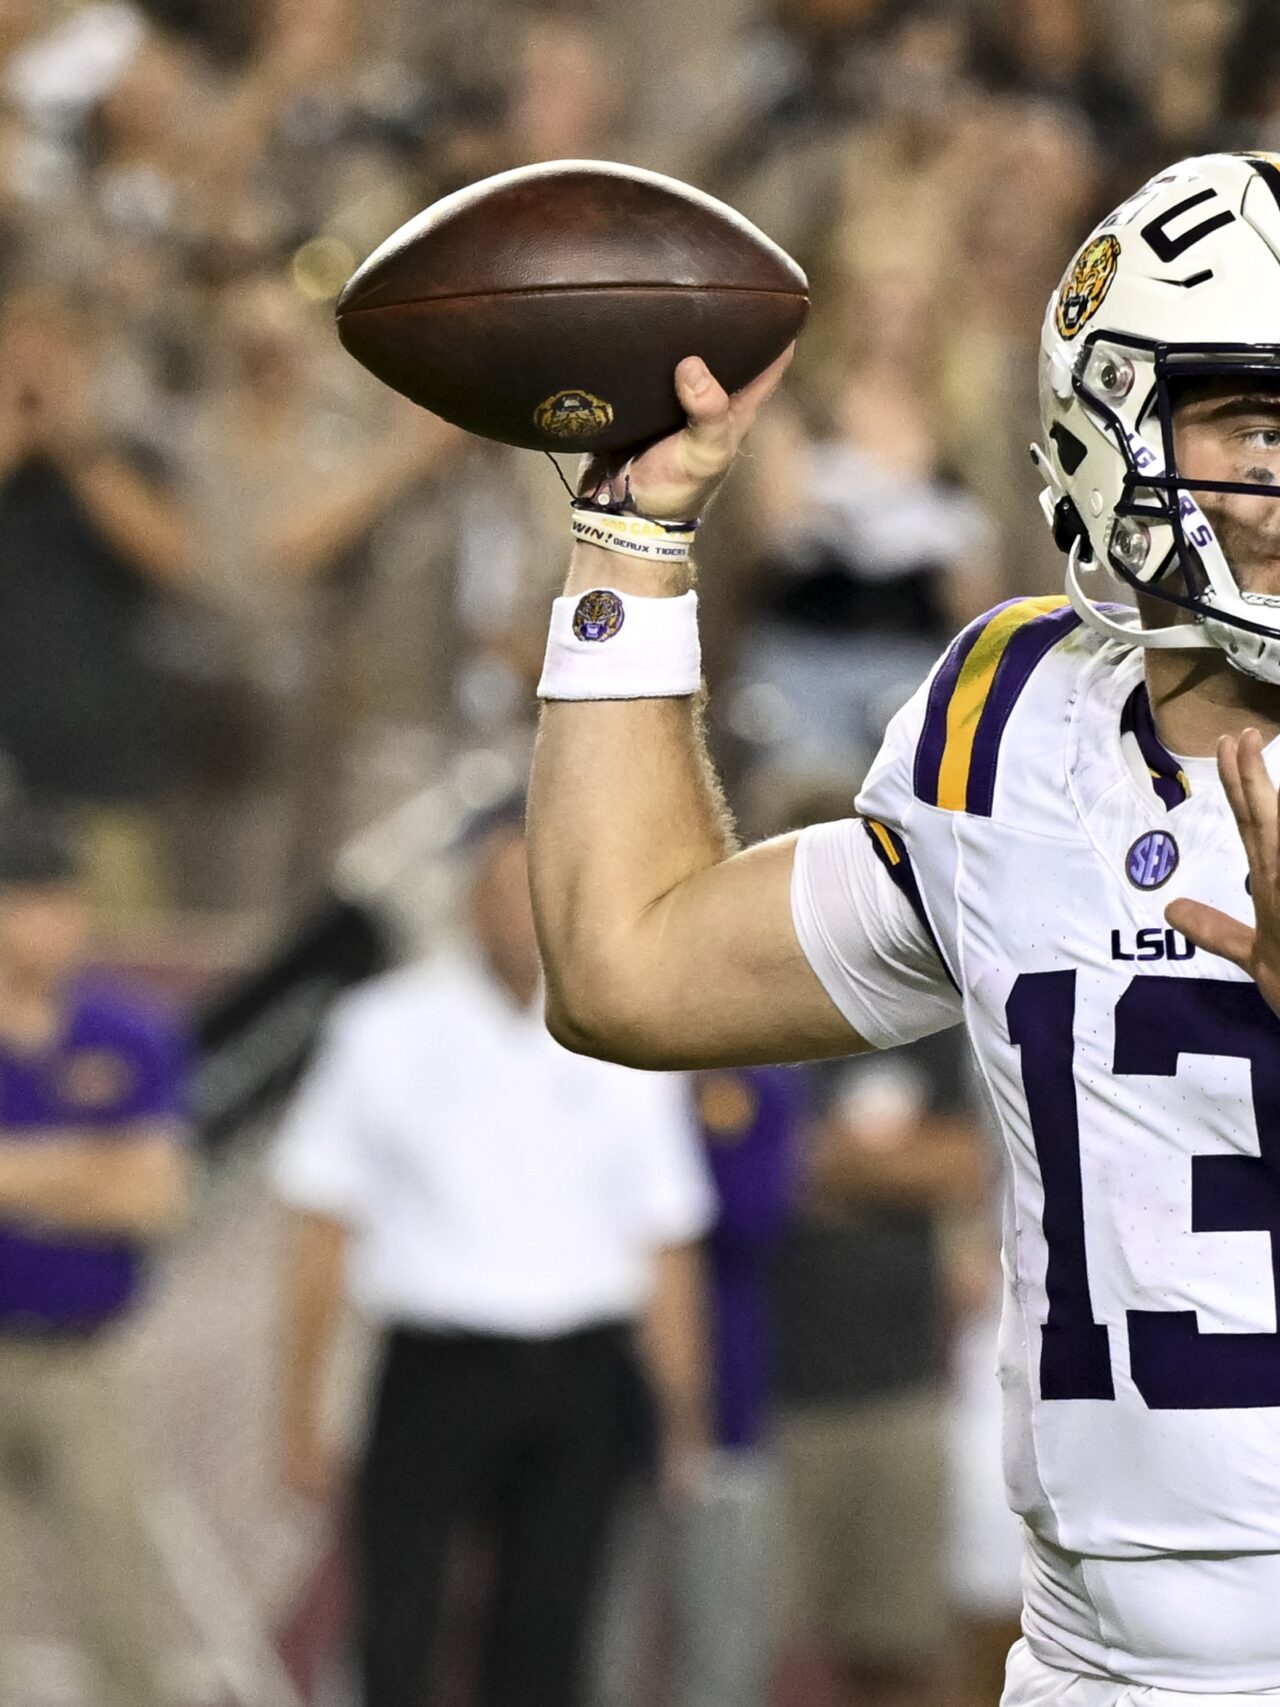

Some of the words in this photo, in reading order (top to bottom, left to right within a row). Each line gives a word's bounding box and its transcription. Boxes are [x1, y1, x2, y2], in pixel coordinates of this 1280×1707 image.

[572, 520, 613, 544] WIN!
[1129, 833, 1176, 886] SEC
[1111, 928, 1197, 961] LSU
